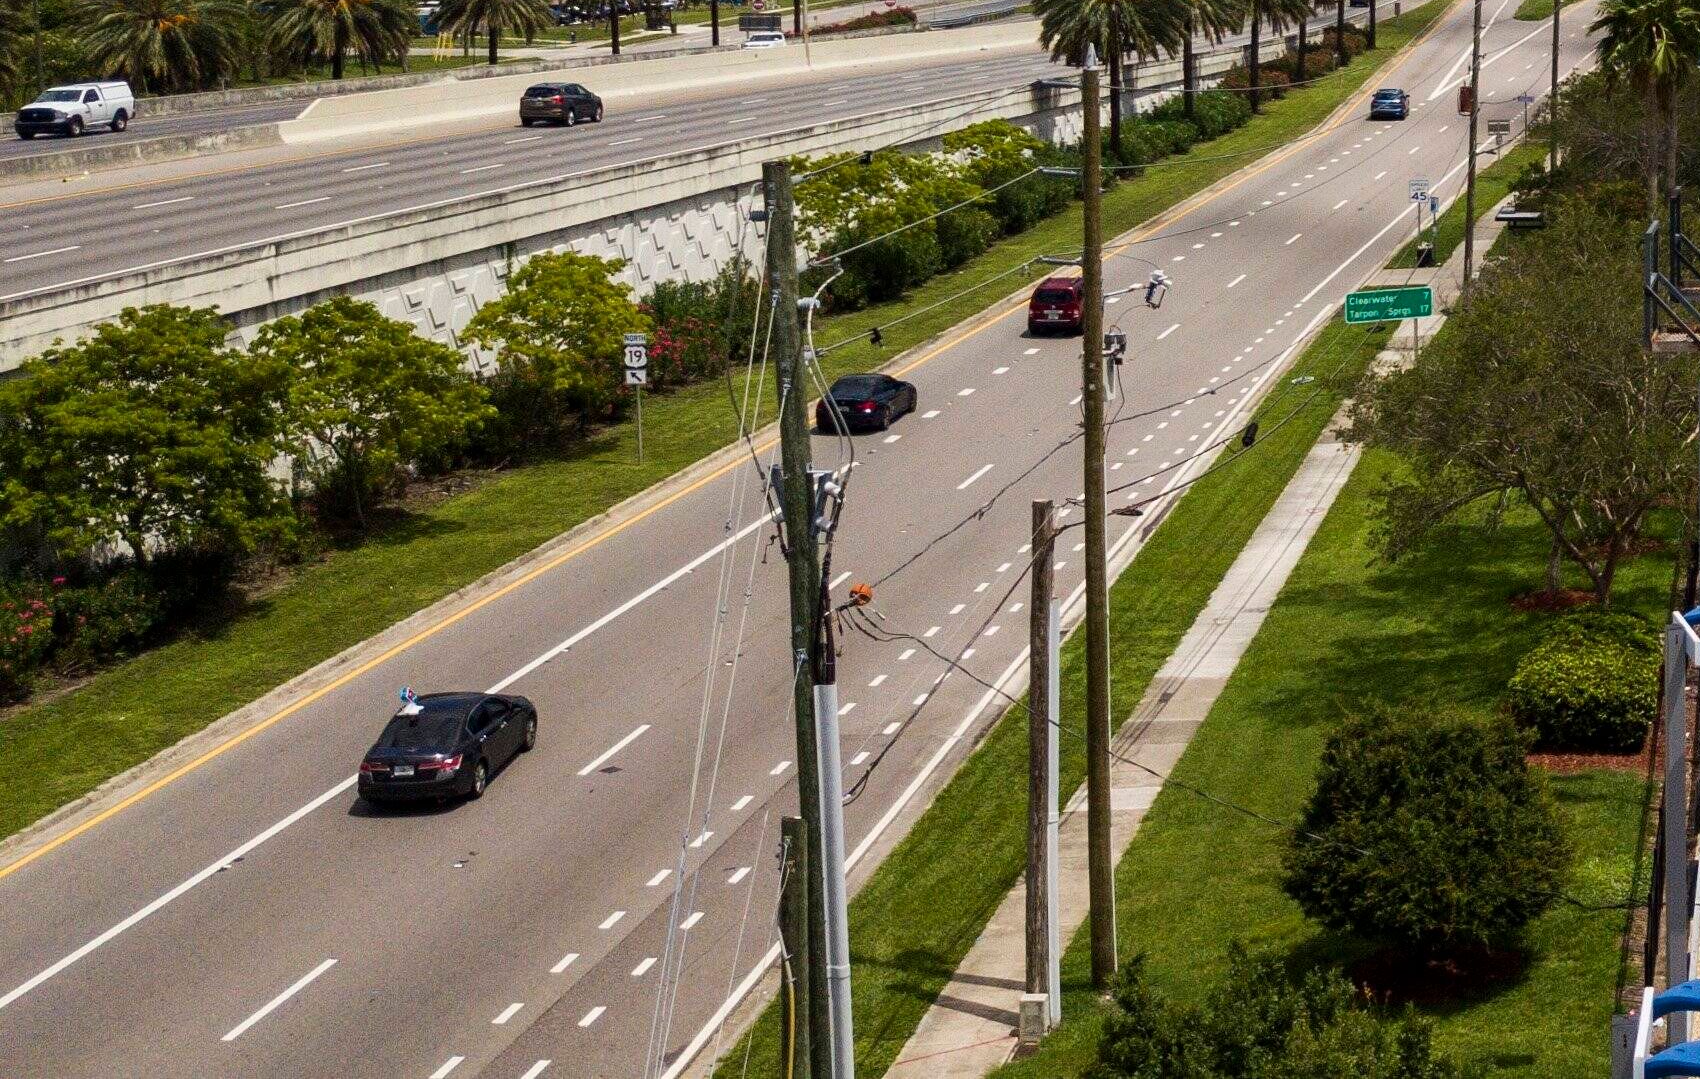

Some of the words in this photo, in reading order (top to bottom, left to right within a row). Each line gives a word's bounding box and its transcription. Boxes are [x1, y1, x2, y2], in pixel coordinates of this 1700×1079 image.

[1411, 192, 1427, 201] 45
[1349, 295, 1398, 306] Clearwater
[1424, 291, 1430, 300] 7
[1349, 310, 1380, 319] Tarpon
[1420, 304, 1430, 313] 17
[628, 350, 643, 363] 19
